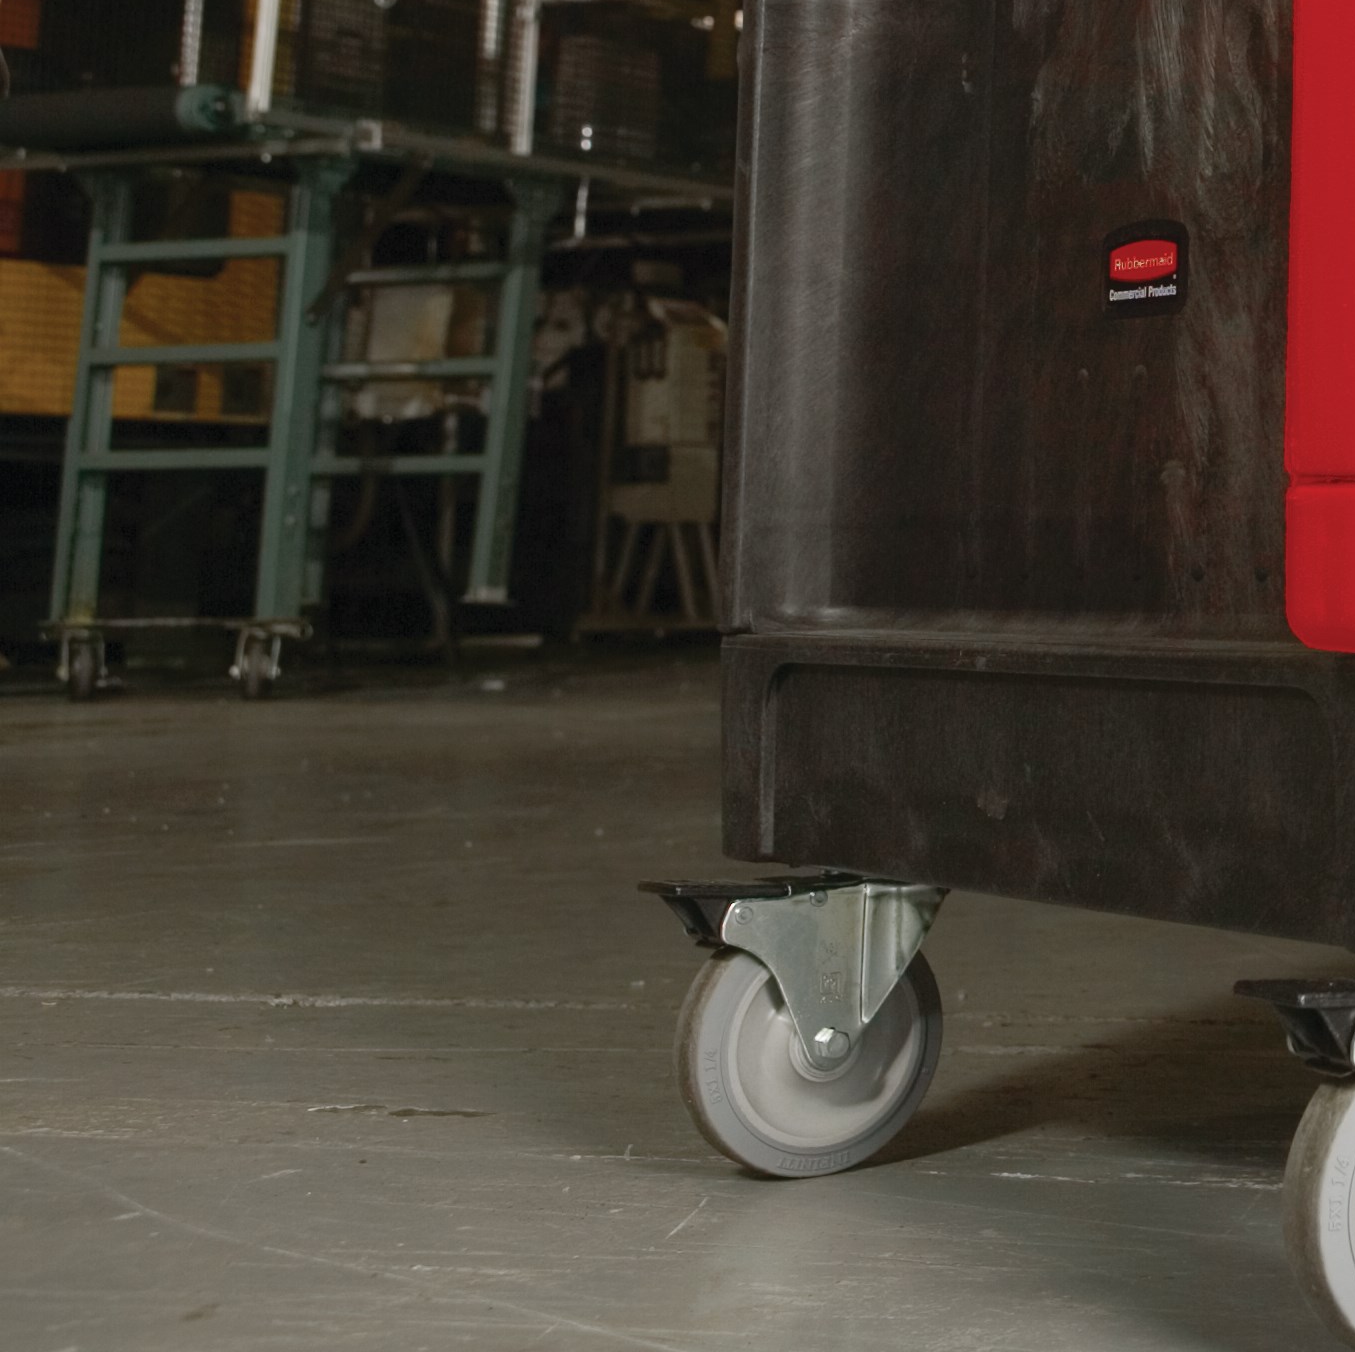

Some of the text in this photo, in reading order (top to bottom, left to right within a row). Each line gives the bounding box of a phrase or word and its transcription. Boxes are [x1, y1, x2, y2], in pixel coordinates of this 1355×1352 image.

[1114, 252, 1174, 271] Rubbermaid
[1109, 283, 1177, 302] Commercial Products
